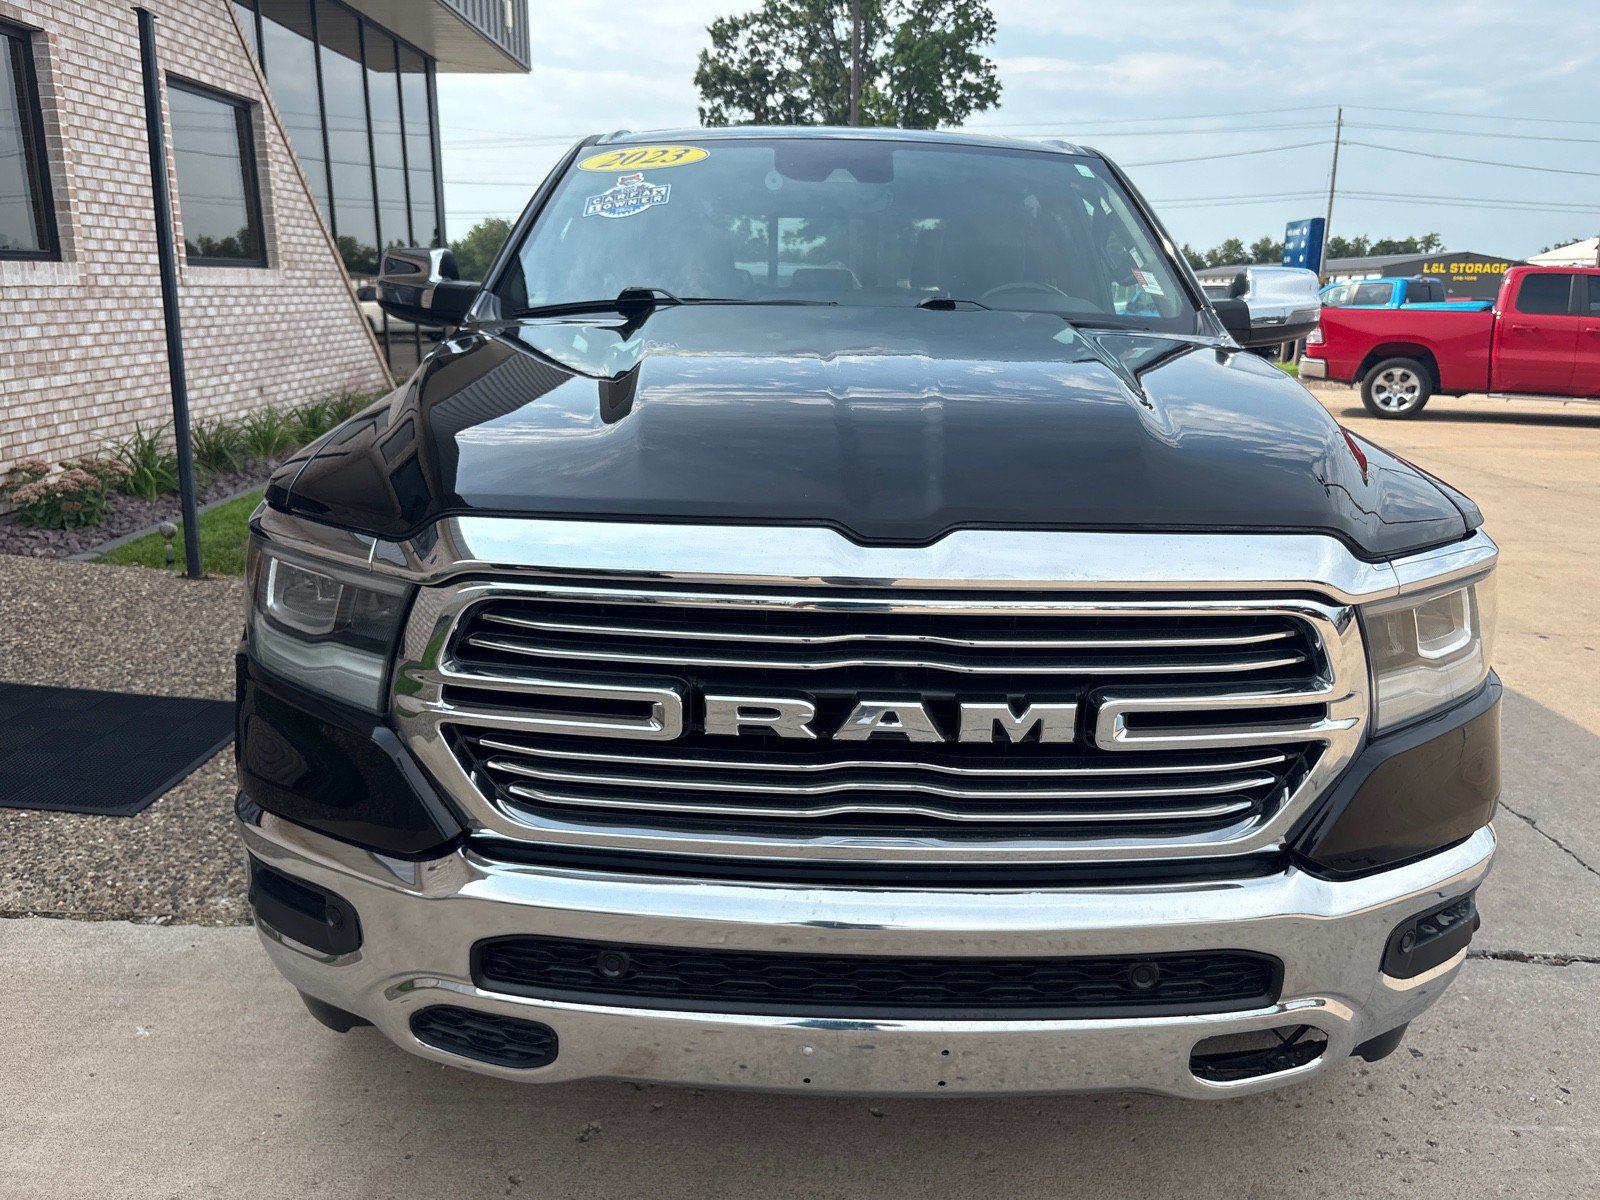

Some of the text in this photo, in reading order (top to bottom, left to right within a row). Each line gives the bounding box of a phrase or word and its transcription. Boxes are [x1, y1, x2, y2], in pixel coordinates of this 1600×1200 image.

[596, 149, 691, 168] 2023
[592, 188, 665, 205] CARFAX
[1423, 262, 1508, 274] L&L STORAGE
[704, 694, 1078, 743] RAM
